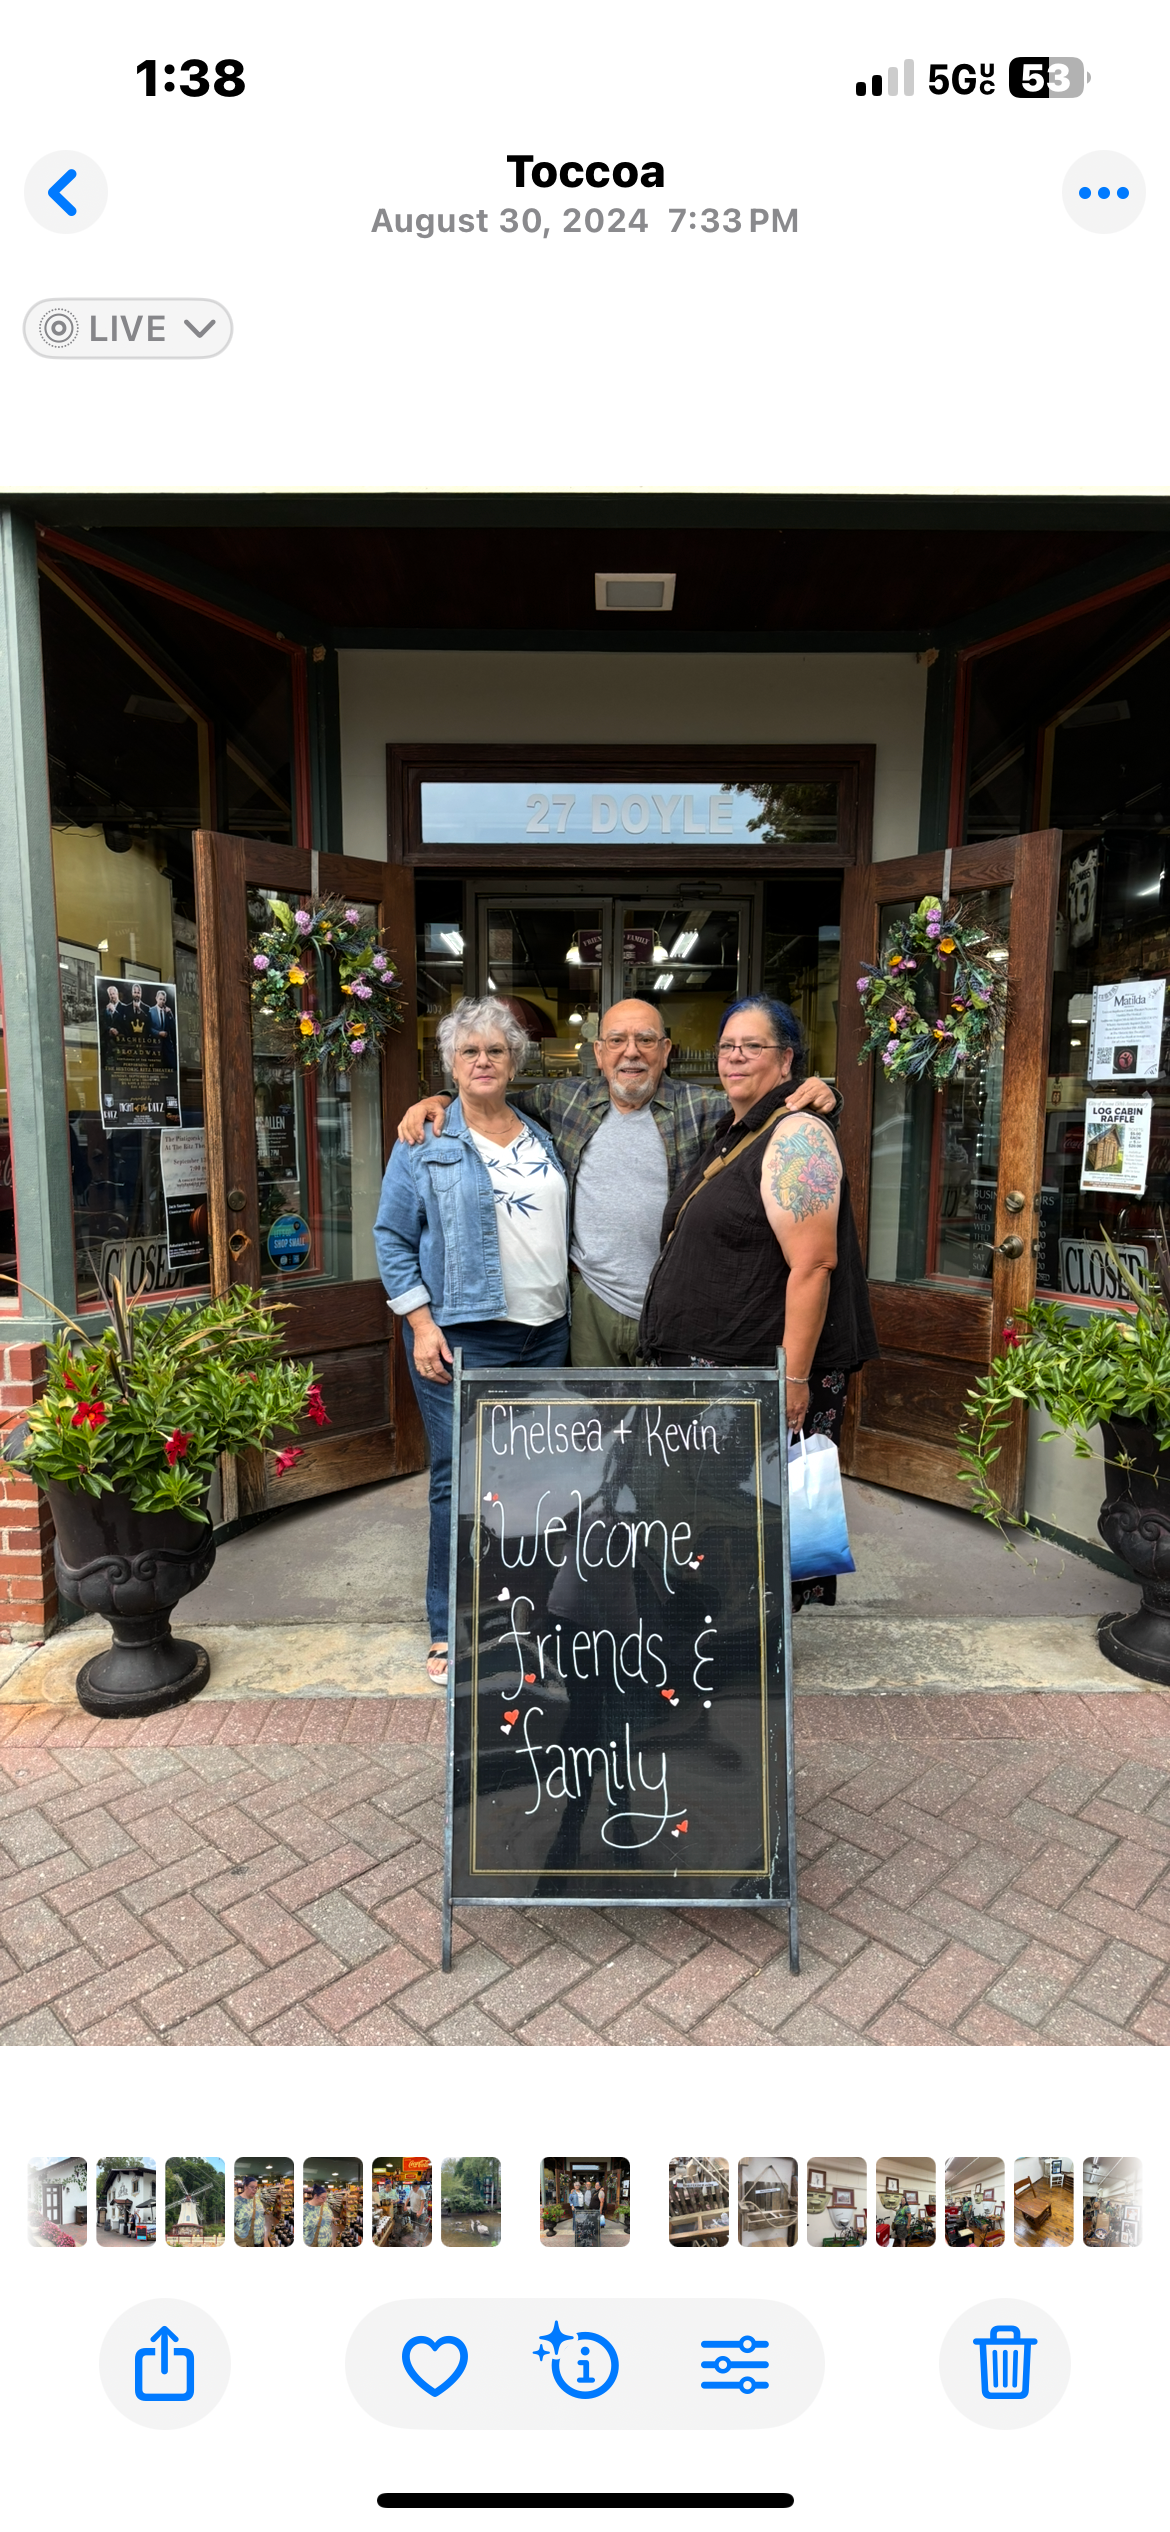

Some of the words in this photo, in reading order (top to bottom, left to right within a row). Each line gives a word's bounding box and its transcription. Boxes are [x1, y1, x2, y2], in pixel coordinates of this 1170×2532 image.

[137, 59, 245, 97] 1:38
[1021, 63, 1071, 92] 53
[507, 155, 664, 188] Toccoa
[371, 208, 488, 238] August
[500, 208, 550, 238] 30,
[564, 208, 648, 233] 2024
[669, 208, 741, 233] 7:33
[751, 208, 797, 233] PM
[90, 316, 165, 342] LIVE
[525, 793, 575, 834] 27
[591, 794, 734, 835] DOYLE
[582, 936, 602, 946] FRIEN
[626, 934, 650, 945] FAMILY
[1114, 994, 1146, 1007] Matilda
[116, 1036, 162, 1044] BACHELORS
[265, 1116, 285, 1129] ALLEN
[174, 1158, 199, 1166] September
[973, 1189, 997, 1200] BUSIN
[974, 1203, 992, 1211] MON
[973, 1233, 988, 1241] THU
[974, 1223, 991, 1232] WED
[274, 1238, 288, 1248] SHOP
[289, 1238, 305, 1247] SMALL
[972, 1253, 985, 1261] SAT
[105, 1244, 180, 1298] COSE
[972, 1263, 988, 1271] SUN
[1065, 1246, 1144, 1300] CLOSED
[491, 1404, 603, 1460] Chelsea
[613, 1420, 633, 1446] +
[645, 1405, 720, 1468] Kevin
[491, 1489, 694, 1595] Welcome
[498, 1596, 670, 1702] friends
[692, 1614, 718, 1709] &
[514, 1705, 688, 1850] family
